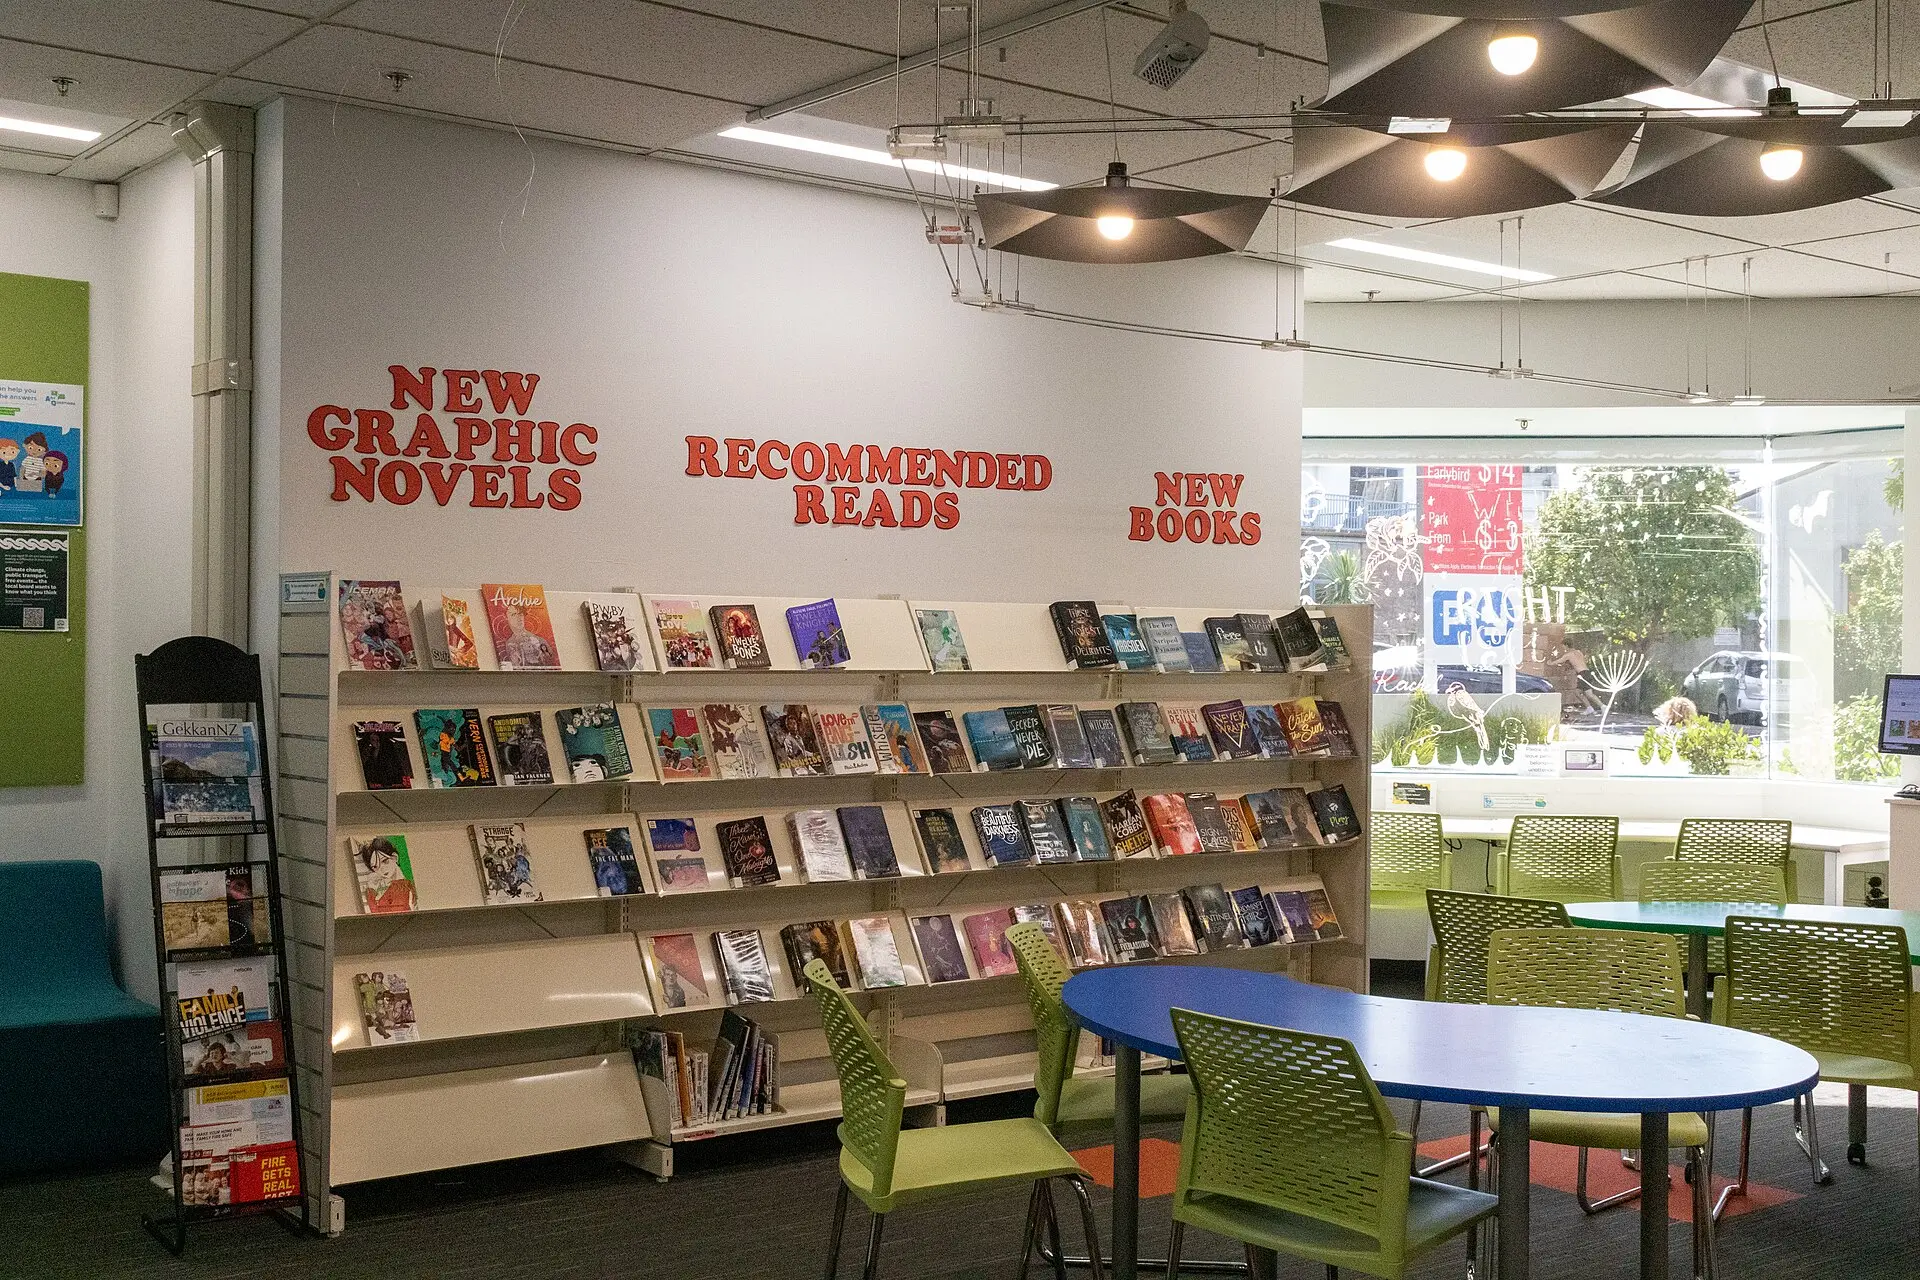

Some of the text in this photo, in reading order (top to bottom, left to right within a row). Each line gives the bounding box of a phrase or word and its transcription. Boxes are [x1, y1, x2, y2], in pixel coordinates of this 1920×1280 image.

[388, 365, 541, 415] NEW
[307, 405, 598, 465] GRAPHIC
[684, 435, 1053, 491] RECOMMENDED
[329, 456, 582, 511] NOVELS
[1154, 471, 1246, 508] NEW
[793, 484, 960, 530] READS
[1127, 506, 1262, 545] BOOKS
[1429, 512, 1448, 525] Park
[1429, 531, 1451, 543] From
[348, 585, 395, 595] ICEMAN
[491, 586, 542, 606] Archie
[592, 603, 625, 616] RWBY
[1161, 622, 1172, 630] Boy
[730, 636, 756, 648] TWELVE
[1115, 640, 1146, 652] MARSDEN
[1154, 638, 1178, 646] Striped
[732, 642, 761, 660] BONES
[820, 713, 847, 728] LOVE
[1170, 714, 1198, 724] REILLY
[1212, 710, 1244, 724] NEVER
[1288, 711, 1316, 731] Catch
[163, 722, 238, 736] GekkanNZ
[468, 720, 480, 742] VERN
[1010, 718, 1038, 732] SECRETS
[1088, 720, 1114, 730] WITCHES
[1016, 731, 1042, 745] NEVER
[1290, 731, 1301, 739] The
[1301, 723, 1324, 742] Sun
[1026, 742, 1046, 760] DIE
[1221, 808, 1239, 822] DIS
[1112, 814, 1142, 832] HARLAN
[1116, 822, 1142, 838] COBEN
[483, 826, 514, 838] STRANGE
[725, 822, 750, 839] Three
[984, 823, 1019, 840] DARKNESS
[1200, 828, 1218, 836] SIGN
[1116, 832, 1151, 853] SHELTER
[1202, 836, 1230, 845] SLAYER
[620, 854, 635, 862] MAN
[230, 866, 249, 875] Kids
[177, 887, 202, 898] hope
[178, 992, 238, 1020] FAMILY
[180, 1004, 246, 1038] VIOLENCE
[262, 1156, 286, 1170] FIRE
[263, 1167, 291, 1180] GETS
[264, 1180, 295, 1193] REAL,
